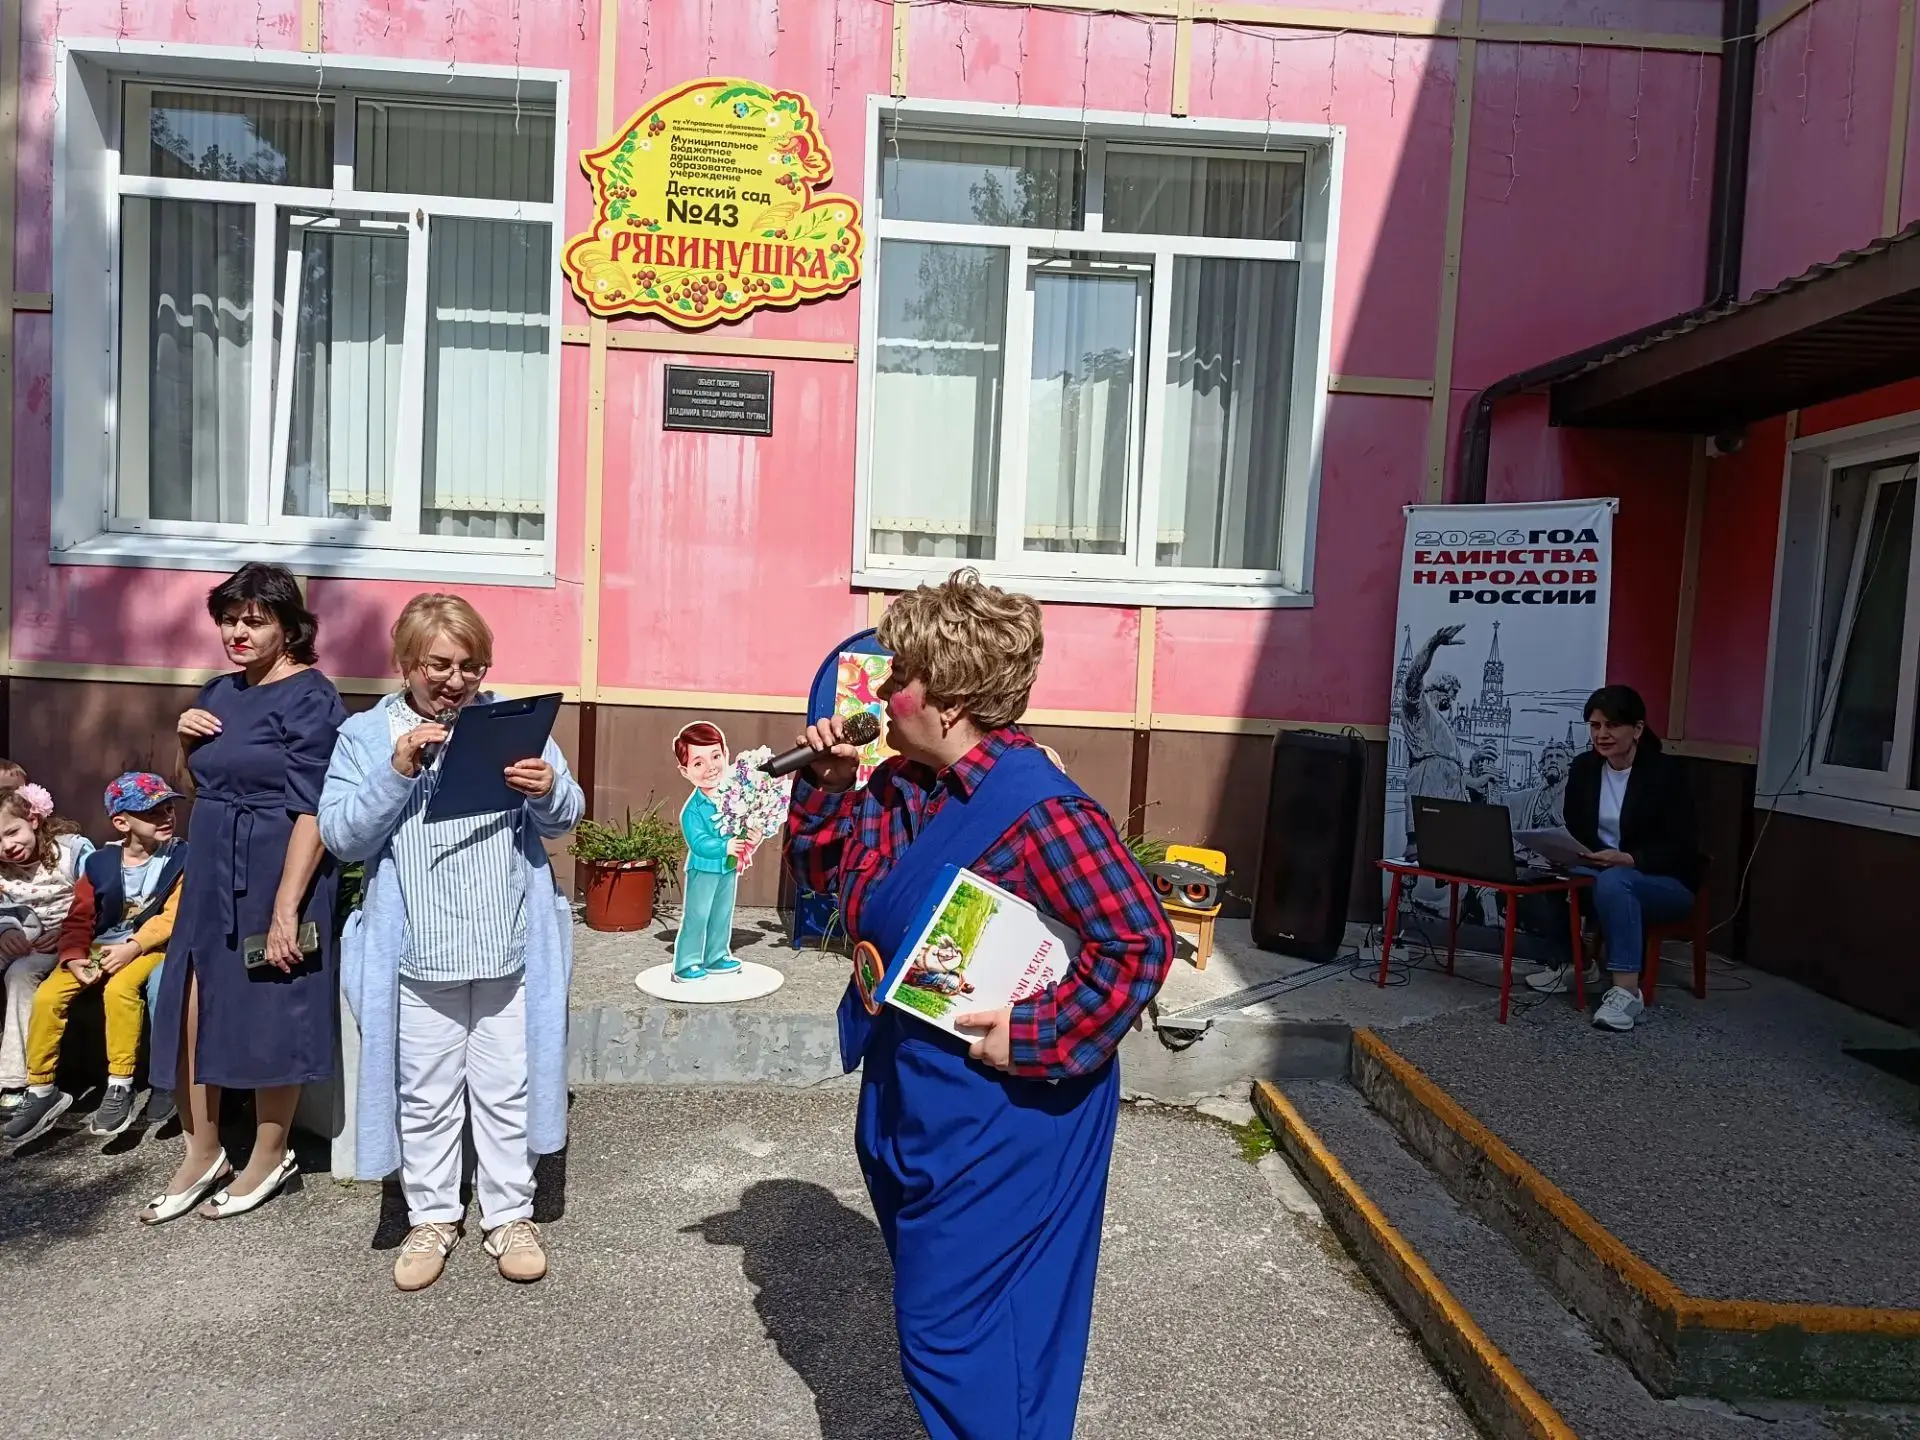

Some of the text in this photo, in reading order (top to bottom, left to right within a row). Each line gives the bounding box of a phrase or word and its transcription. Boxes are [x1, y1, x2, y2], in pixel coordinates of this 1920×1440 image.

[670, 143, 732, 156] бюджетное
[671, 134, 759, 151] Муниципальное
[670, 153, 736, 165] дошкольное
[669, 161, 763, 176] образовательное
[669, 169, 741, 182] учереждение
[665, 180, 771, 205] Детский сад
[666, 199, 739, 228] №43
[610, 230, 830, 279] РЯБИНУШКА
[698, 378, 740, 388] ОБЪЕКТ ПОСТРОЕН
[691, 398, 745, 408] РОССИЙСКОЙ ФЕДЕРАЦИИ
[669, 407, 766, 421] ВЛАДИМИРА ВЛАДИМИРОВИЧА ПУТИНА
[1414, 528, 1599, 547] 2026 ГОД
[1414, 548, 1599, 566] ЕДИНСТВА
[1413, 569, 1598, 586] НАРОДОВ
[1448, 589, 1597, 605] РОССИИ
